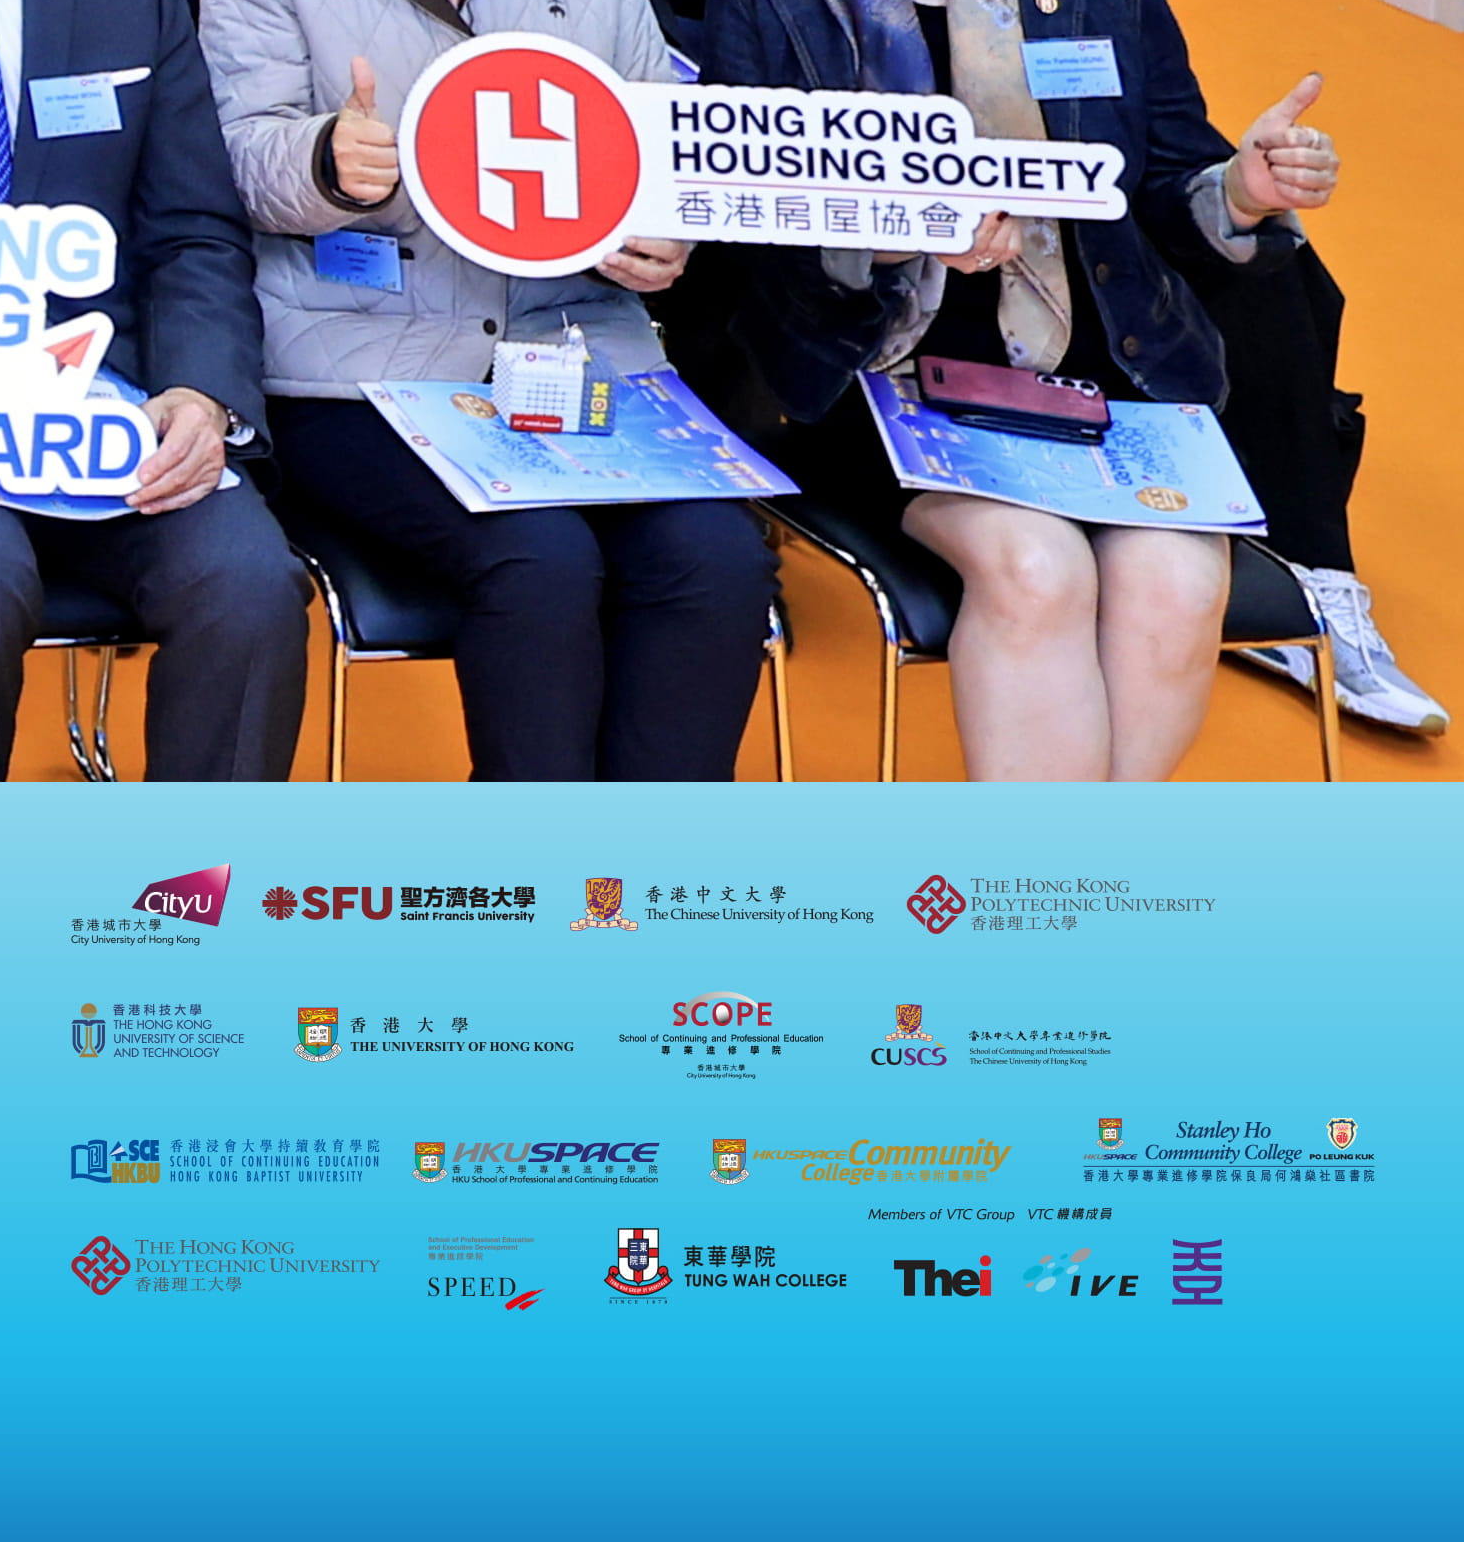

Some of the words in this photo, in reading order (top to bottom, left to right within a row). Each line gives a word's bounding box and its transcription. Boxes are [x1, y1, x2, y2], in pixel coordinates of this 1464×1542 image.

[670, 100, 806, 139] HONG
[822, 107, 957, 145] KONG
[671, 142, 885, 184] HOUSING
[901, 151, 1106, 193] SOCIETY
[674, 190, 963, 239] 香港房屋協會
